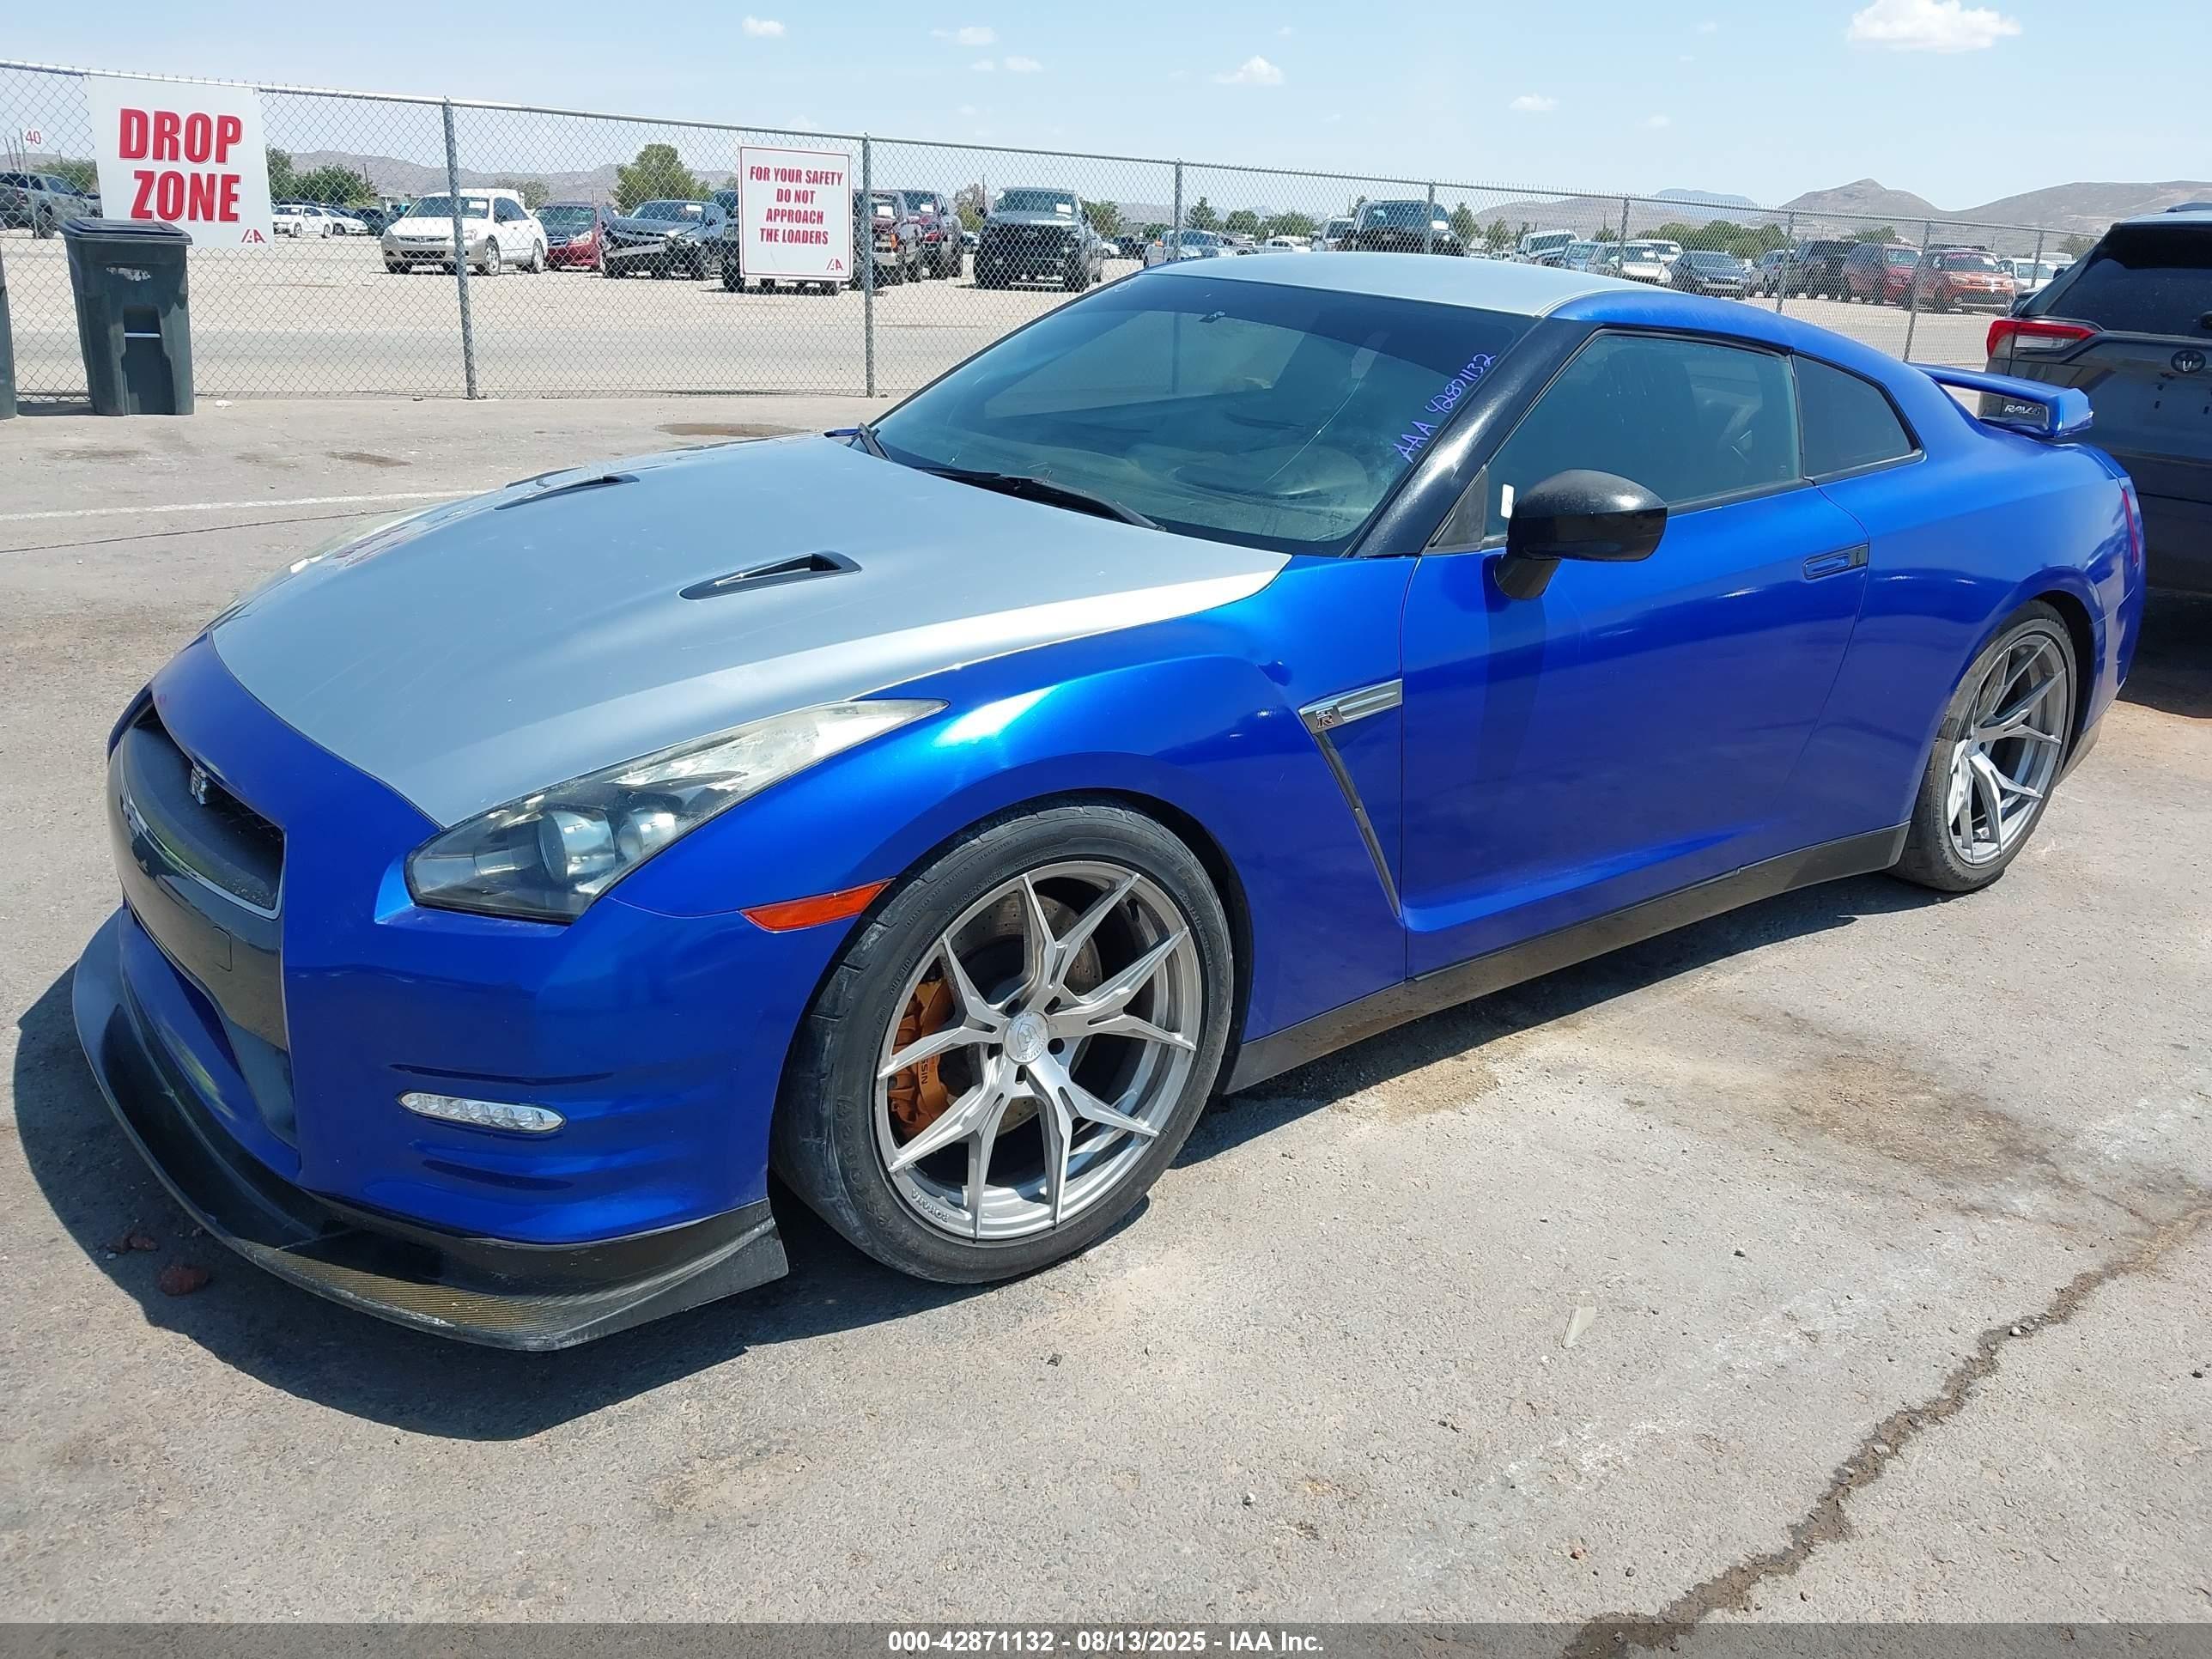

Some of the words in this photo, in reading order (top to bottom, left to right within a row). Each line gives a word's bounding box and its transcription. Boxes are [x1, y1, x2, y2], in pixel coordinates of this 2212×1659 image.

[26, 131, 41, 144] 40
[118, 107, 243, 165] DROP
[750, 166, 770, 181] FOR
[774, 167, 802, 184] YOUR
[805, 170, 843, 186] SAFETY
[131, 169, 241, 223] ZONE
[776, 188, 791, 203] DO
[794, 190, 816, 204] NOT
[766, 208, 823, 225] APPROACH
[760, 228, 780, 242] THE
[782, 228, 829, 245] LOADERS
[1425, 353, 1497, 413] 42871132
